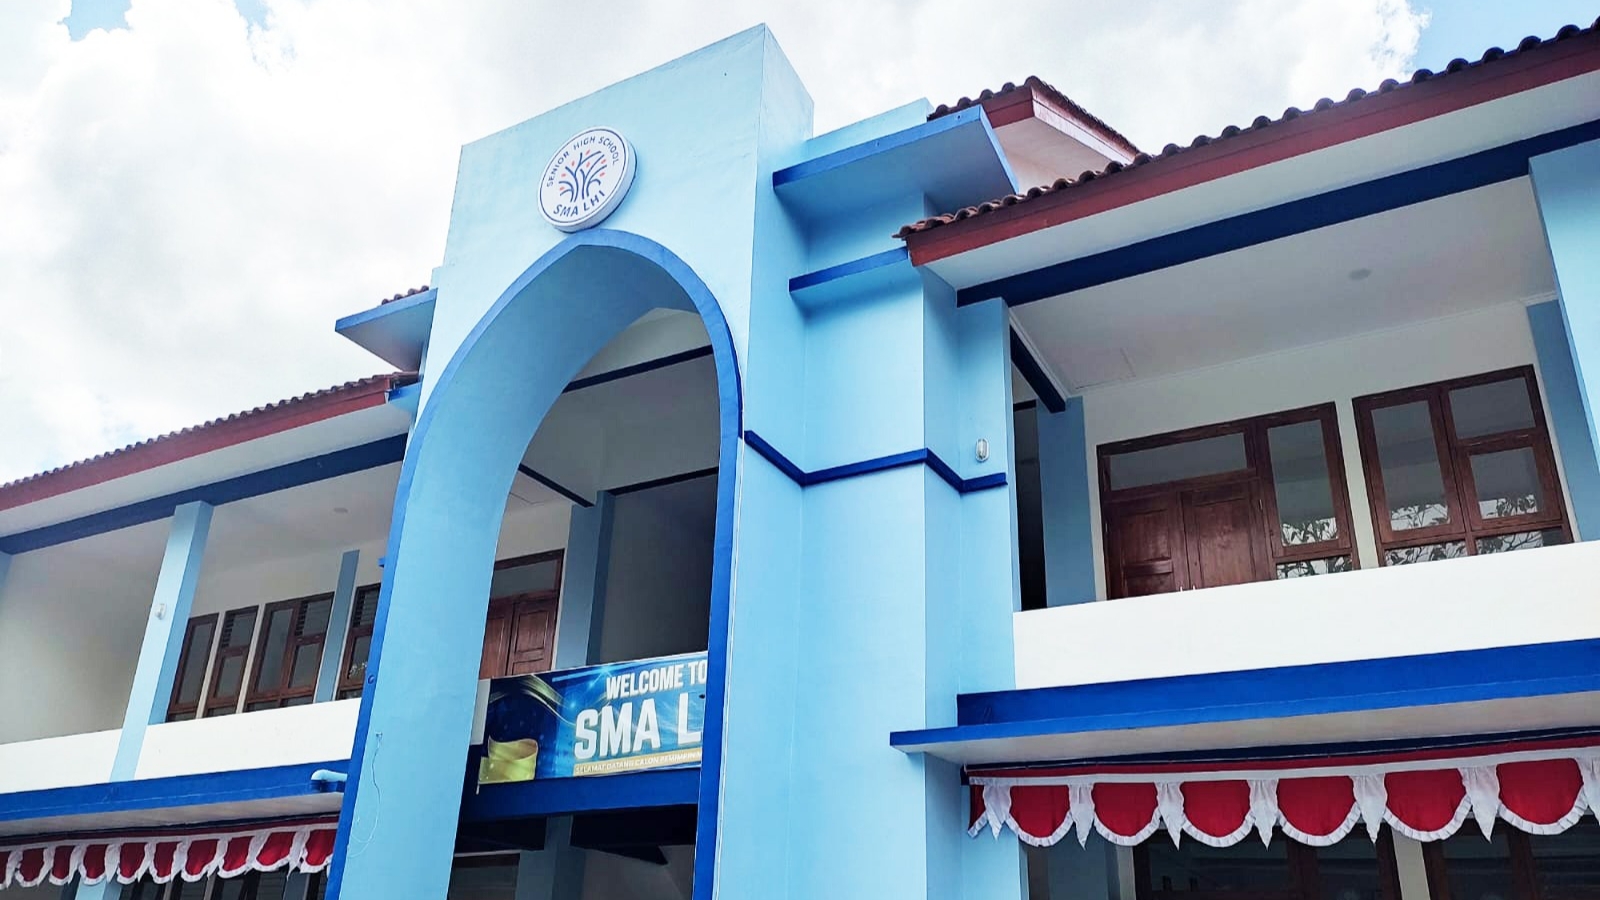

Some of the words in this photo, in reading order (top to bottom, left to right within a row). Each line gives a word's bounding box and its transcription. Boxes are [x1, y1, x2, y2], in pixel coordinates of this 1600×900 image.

[546, 151, 570, 188] SENIOR
[573, 136, 596, 150] HIGH
[598, 136, 620, 165] SCHOOL
[553, 204, 579, 218] SMA
[583, 190, 605, 211] LHI
[606, 664, 685, 700] WELCOME
[688, 659, 707, 686] TO
[574, 698, 661, 760] SMA
[574, 762, 607, 774] SELAMAT
[607, 759, 635, 770] DATANG
[635, 756, 660, 767] CALON
